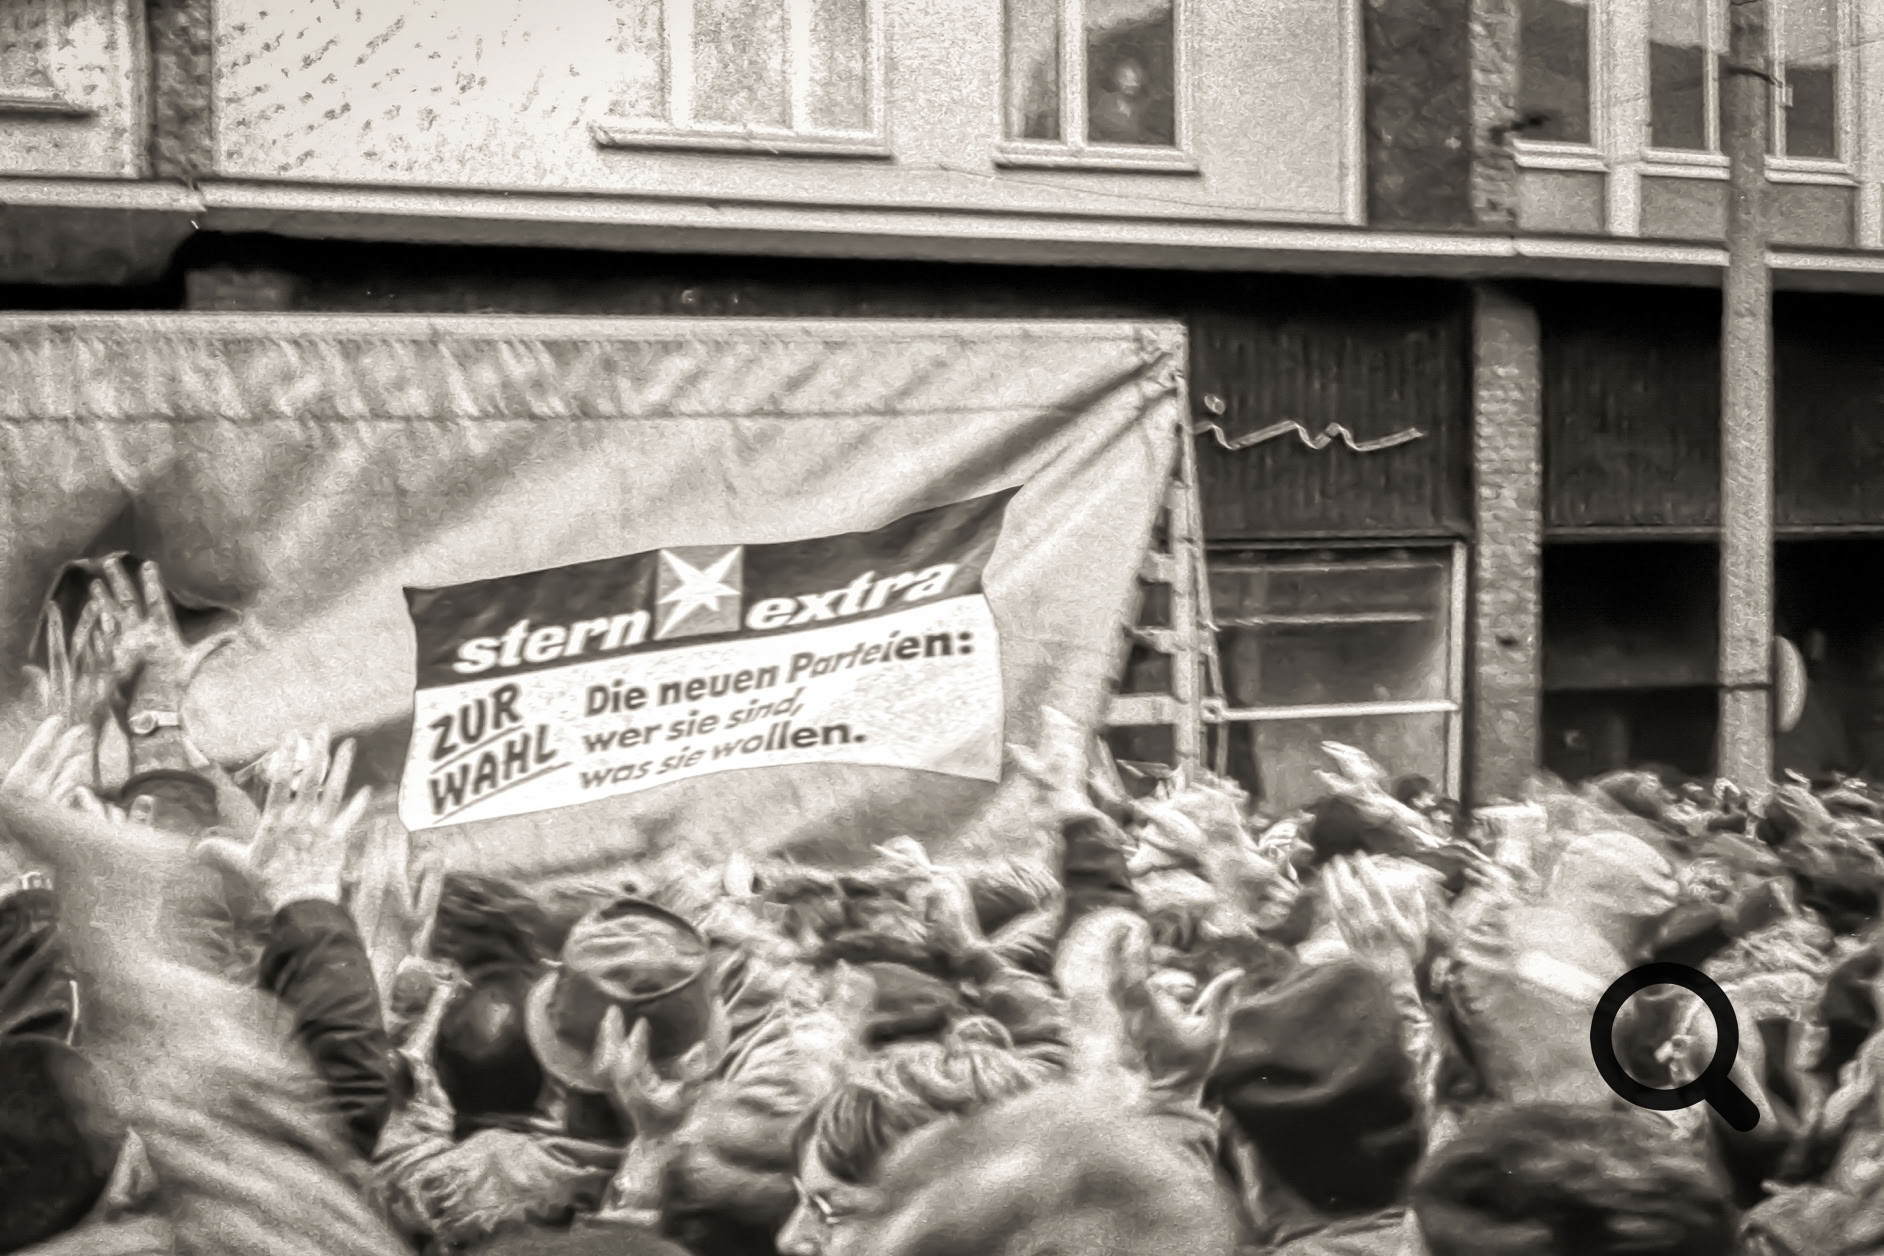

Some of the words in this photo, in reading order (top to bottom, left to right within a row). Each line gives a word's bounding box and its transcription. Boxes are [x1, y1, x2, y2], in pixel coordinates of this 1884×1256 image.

[453, 611, 651, 674] stern
[745, 562, 958, 631] extra
[585, 679, 648, 718] Die
[656, 665, 780, 708] neuen
[786, 630, 976, 681] Parteien:
[430, 683, 524, 762] ZUR
[580, 760, 652, 790] was
[656, 747, 705, 777] sie
[711, 719, 868, 763] wollen.
[583, 724, 662, 755] wer
[666, 710, 720, 742] sie
[723, 688, 806, 731] sind,
[429, 725, 558, 816] WAHL
